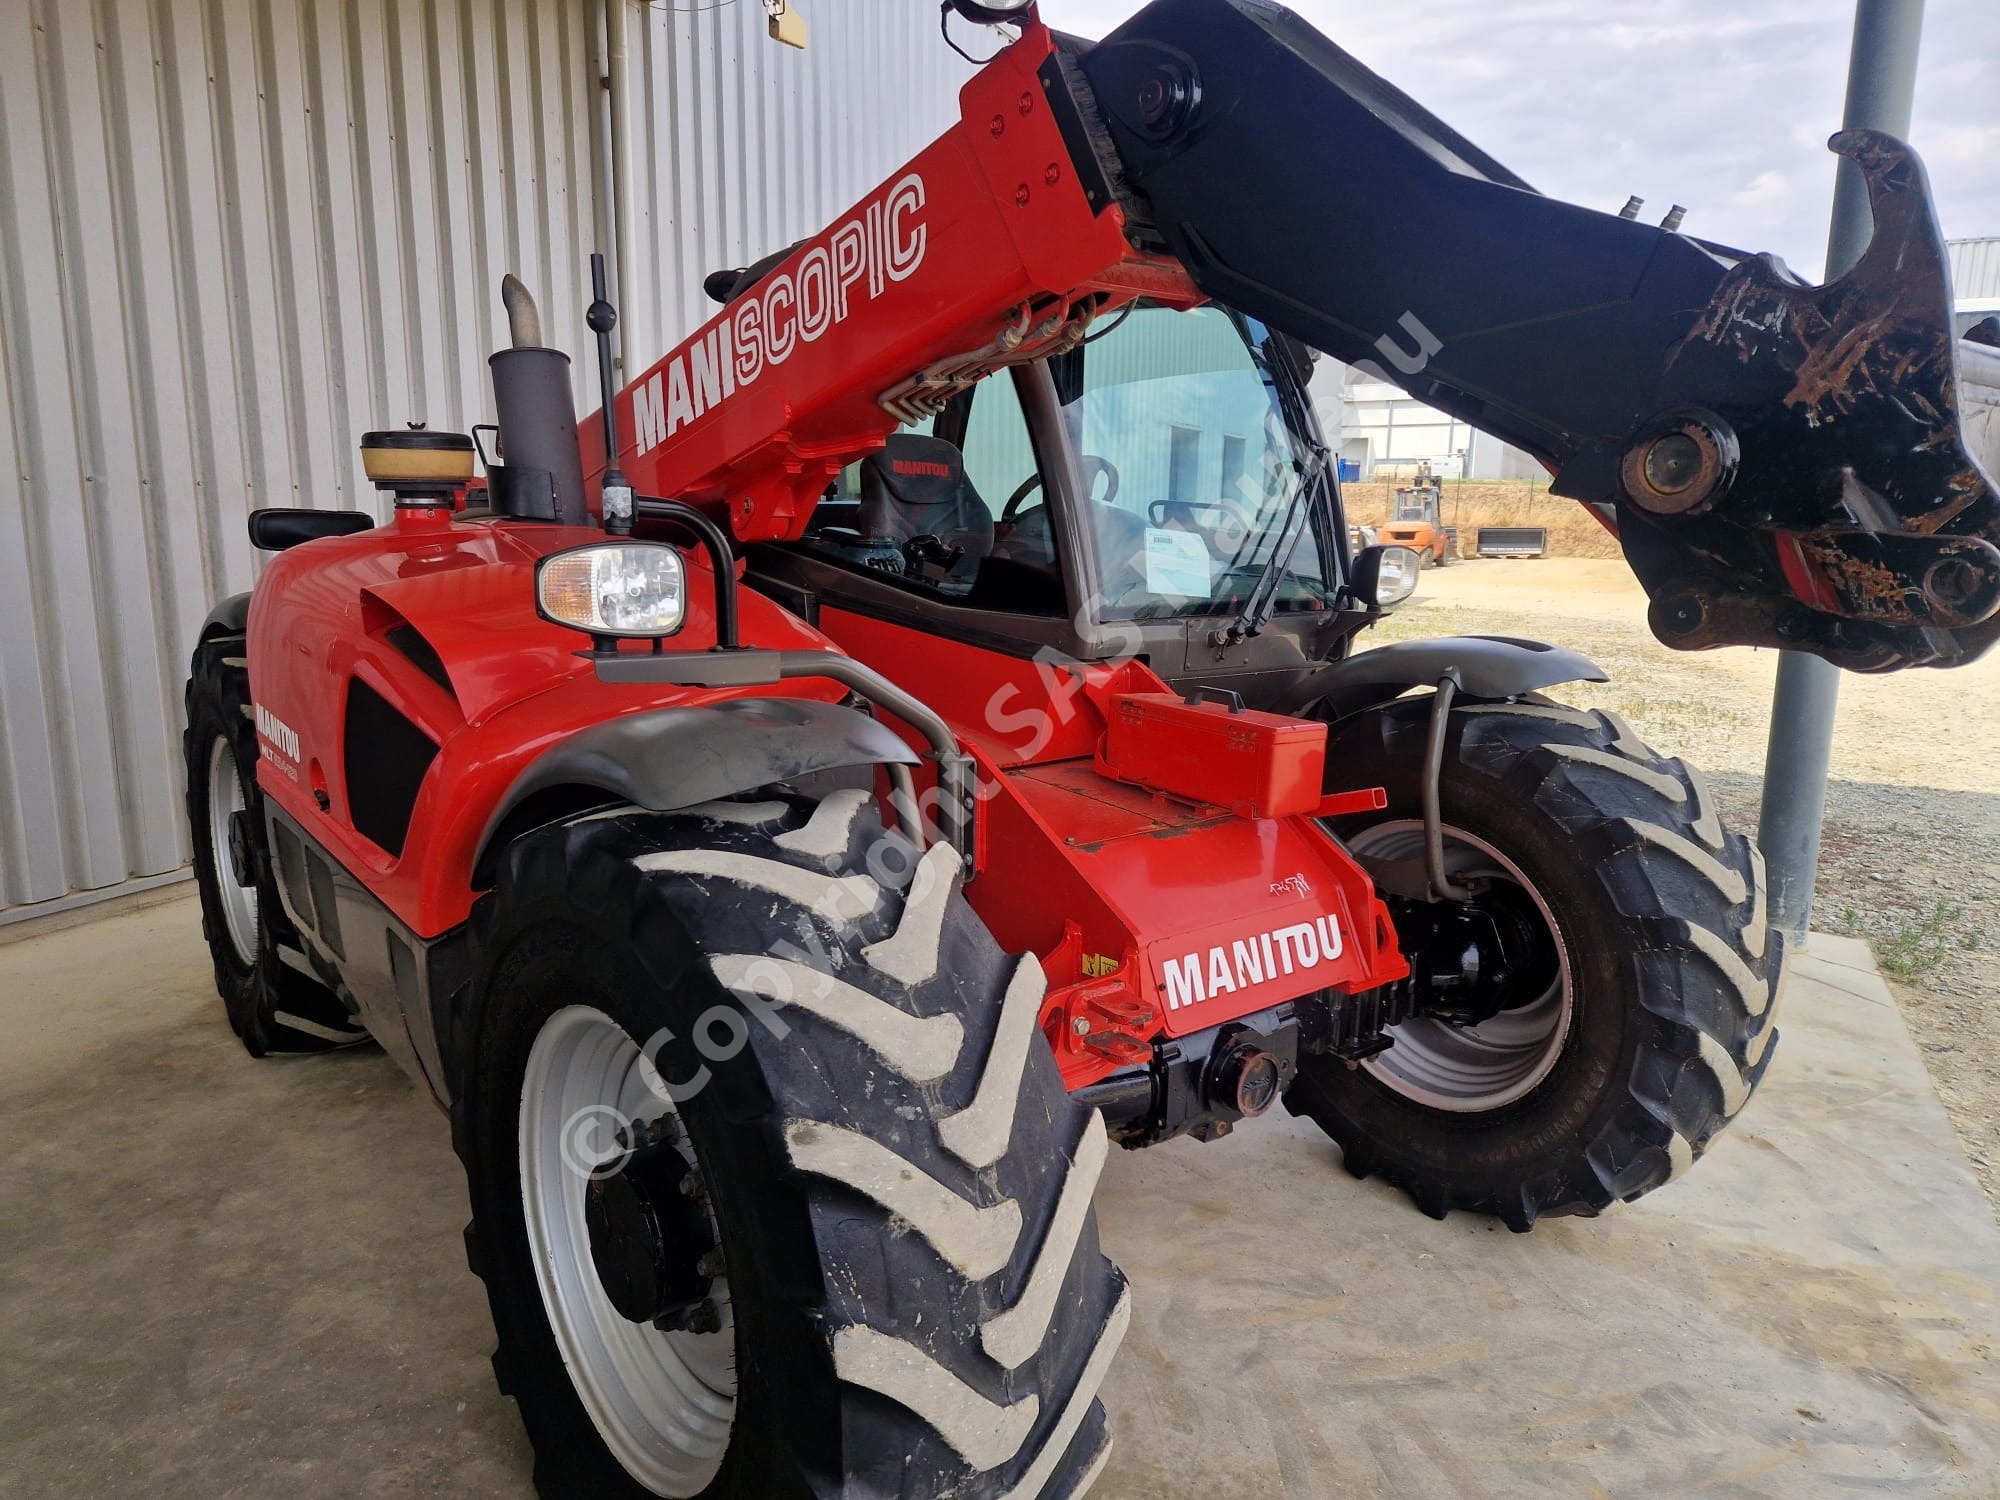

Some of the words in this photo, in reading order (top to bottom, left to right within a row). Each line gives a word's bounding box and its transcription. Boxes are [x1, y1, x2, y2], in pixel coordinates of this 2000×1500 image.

[633, 173, 927, 458] MANISCOPIC
[892, 459, 949, 477] MANITOU
[256, 702, 301, 764] MANITOU
[1162, 913, 1344, 1011] MANITOU
